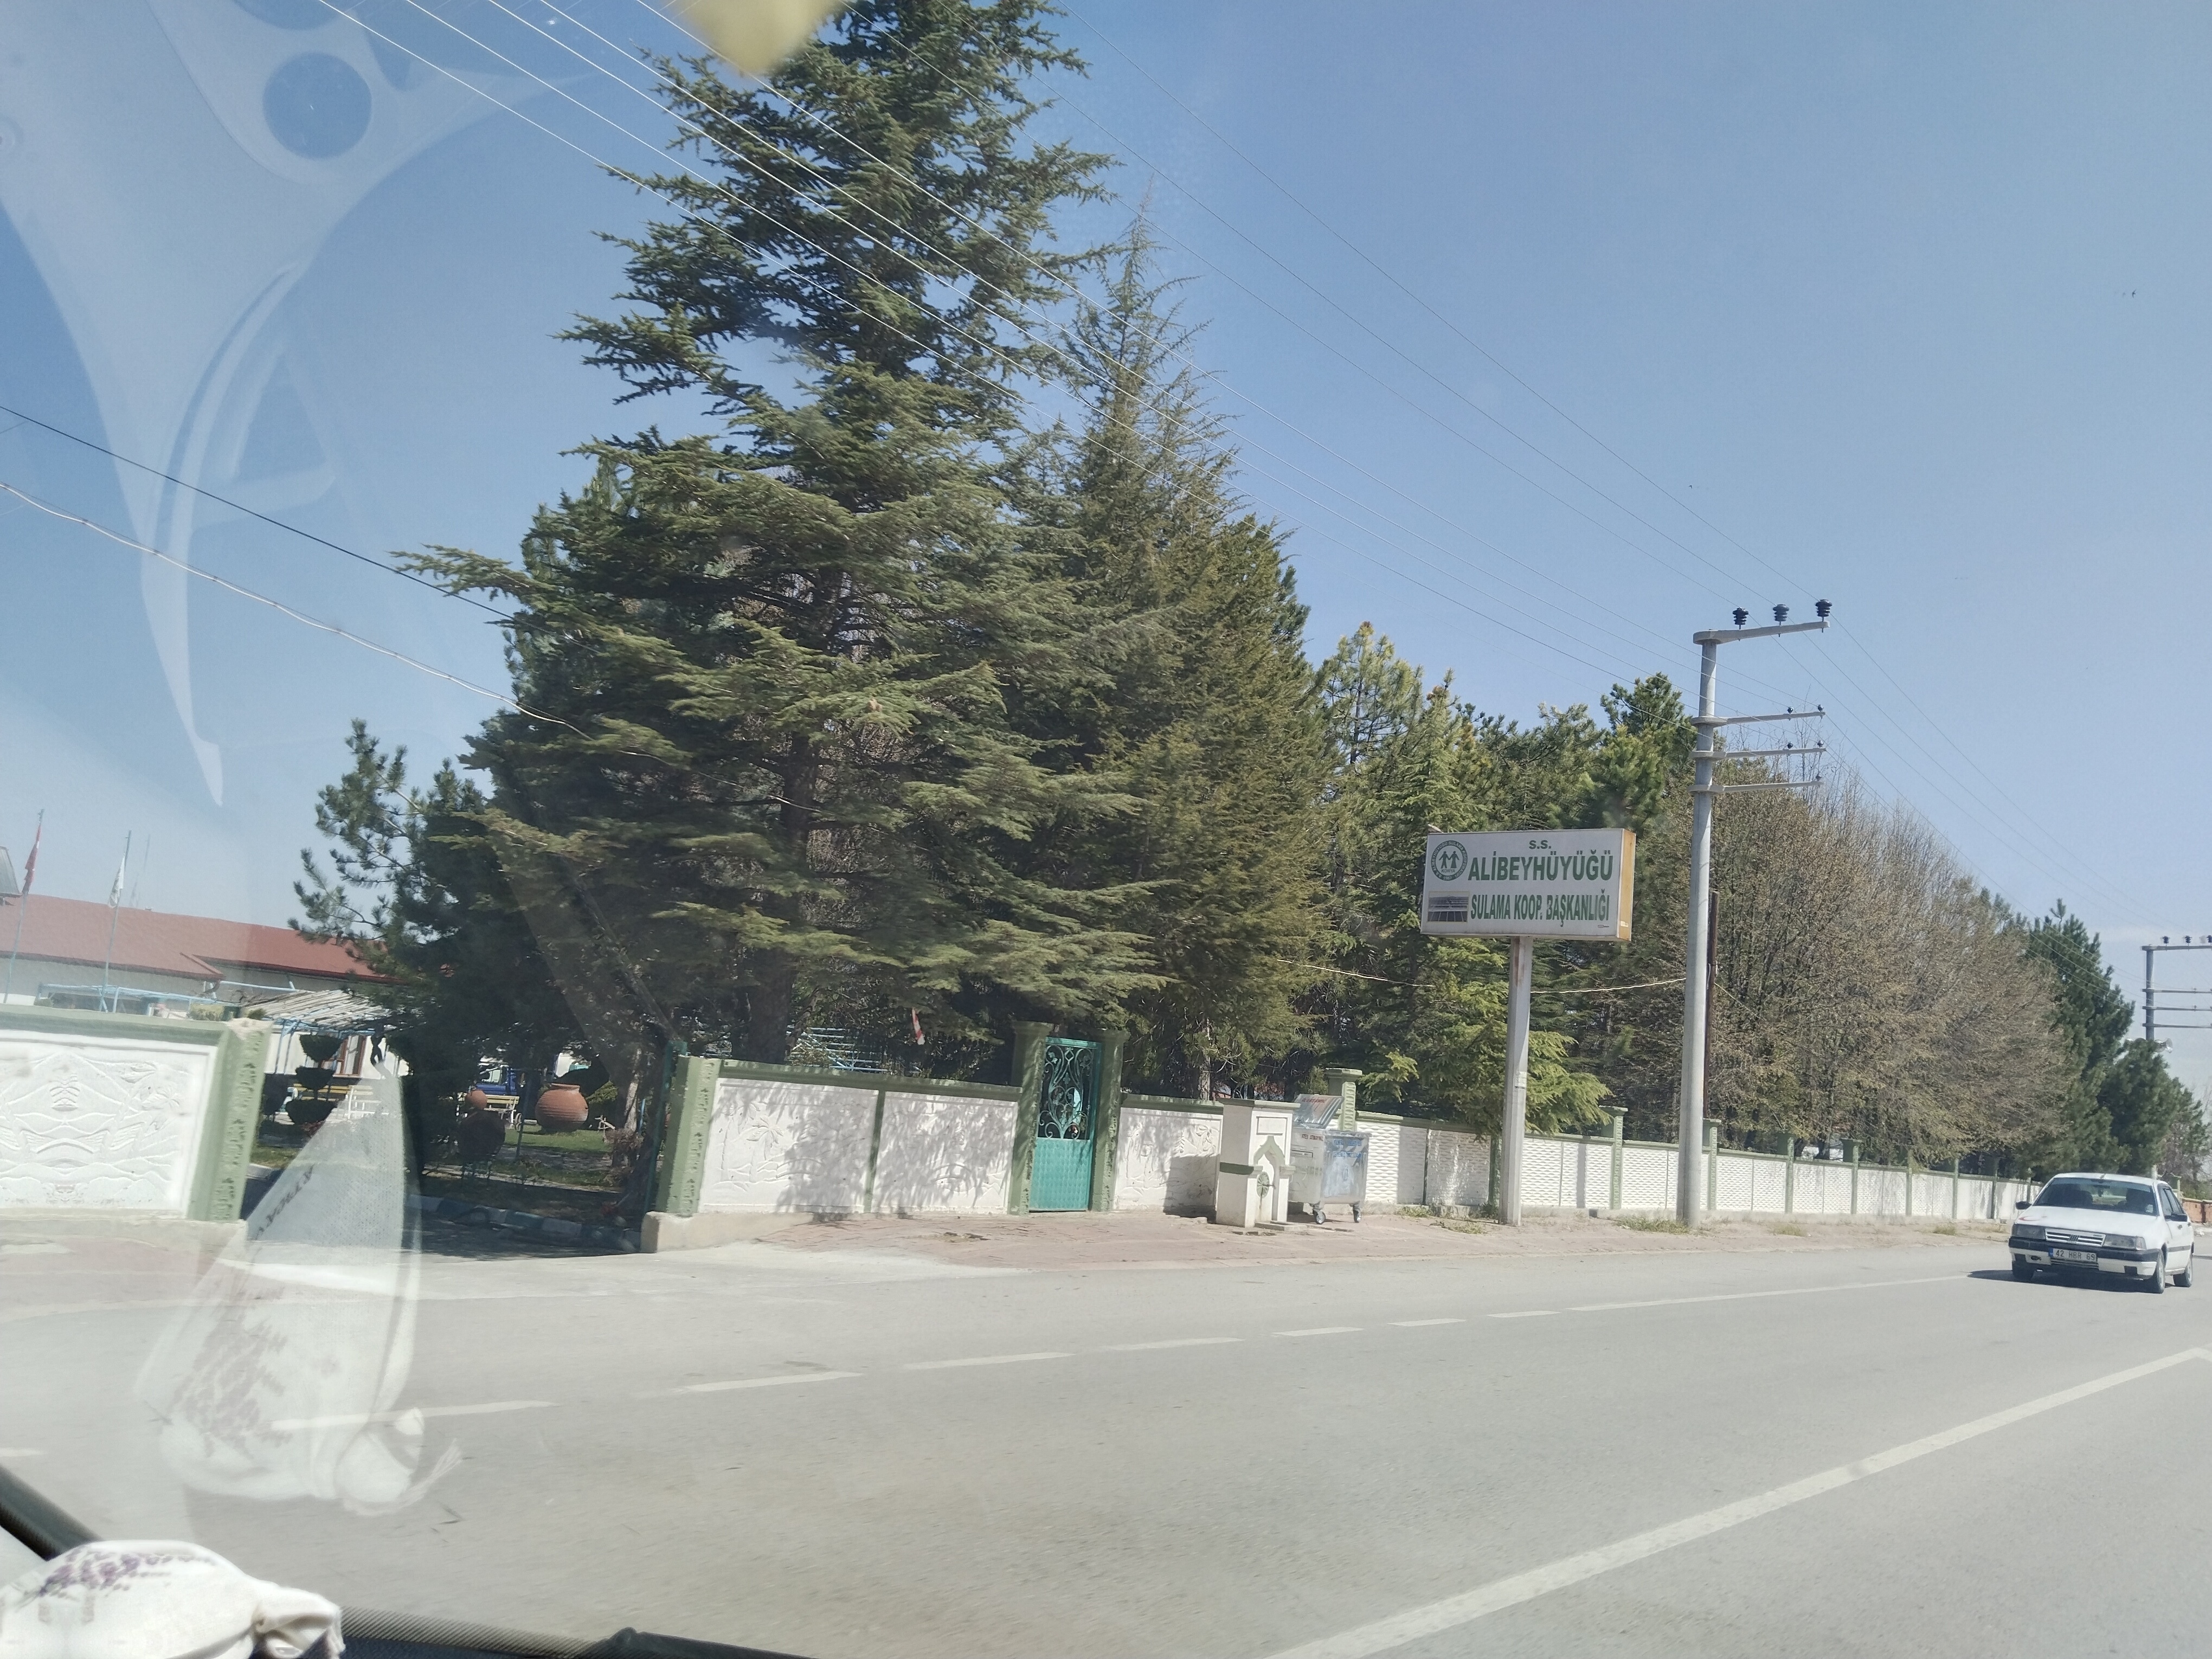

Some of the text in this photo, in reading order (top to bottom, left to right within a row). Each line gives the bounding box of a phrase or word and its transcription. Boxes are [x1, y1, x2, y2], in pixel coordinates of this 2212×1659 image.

[1529, 840, 1552, 850] S.S.
[1468, 849, 1613, 881] ALİBEYHÜYÜĞÜ
[1471, 888, 1610, 927] SULAMA KOOP. BAŞKANLIĞI
